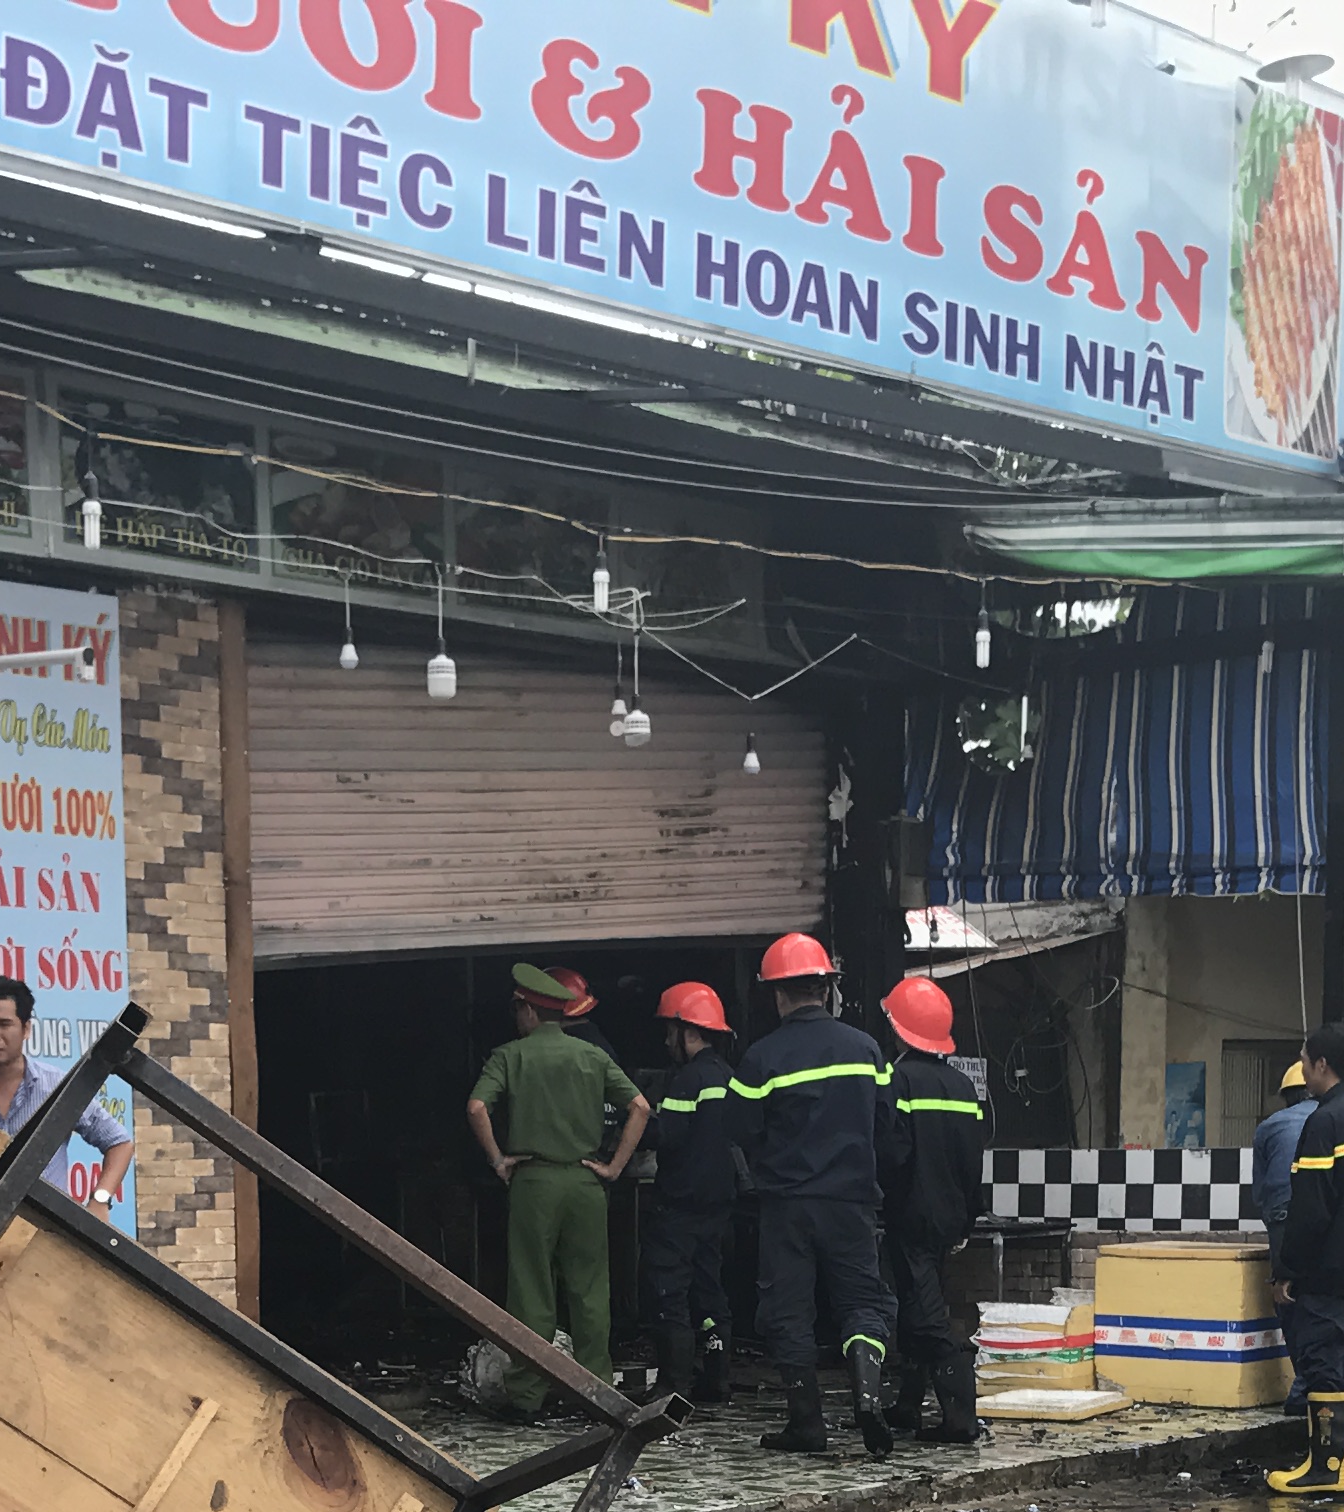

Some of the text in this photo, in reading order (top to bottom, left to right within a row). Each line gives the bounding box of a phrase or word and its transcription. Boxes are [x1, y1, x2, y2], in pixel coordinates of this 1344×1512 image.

[531, 38, 653, 161] &
[693, 84, 946, 258] HẢI
[981, 168, 1209, 334] SẢN
[0, 36, 208, 168] ĐẶT
[244, 103, 454, 228] TIỆC
[485, 173, 666, 289] LIÊN
[695, 232, 879, 343] HOAN
[902, 291, 1041, 383] SINH
[1064, 334, 1205, 425] NHẬT
[52, 787, 116, 841] 100%
[37, 852, 101, 914] SẢN
[38, 928, 123, 993] SỐNG
